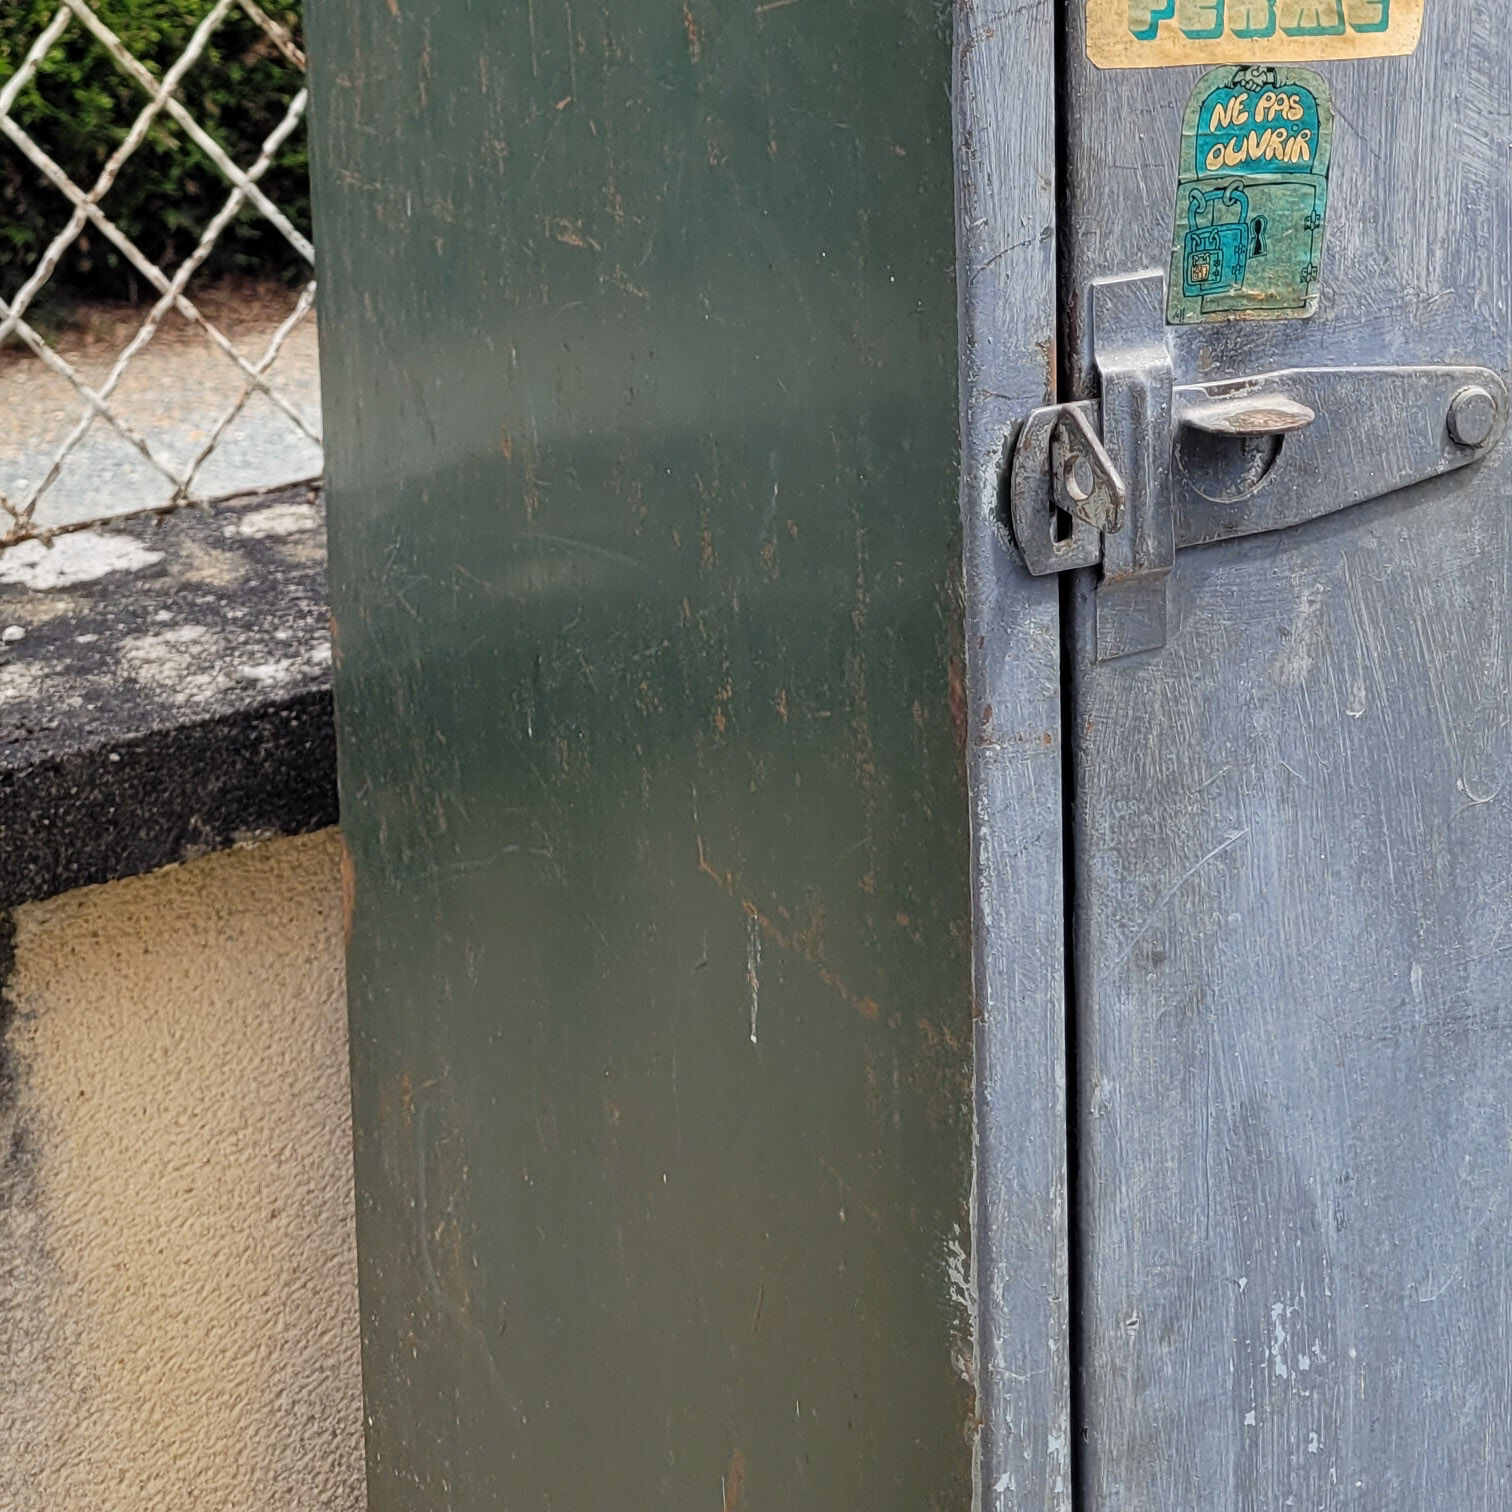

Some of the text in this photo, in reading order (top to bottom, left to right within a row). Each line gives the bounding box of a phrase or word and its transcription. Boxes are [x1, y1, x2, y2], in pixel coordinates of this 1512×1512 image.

[1209, 91, 1304, 133] NE PAS
[1205, 127, 1312, 171] OUVRIR
